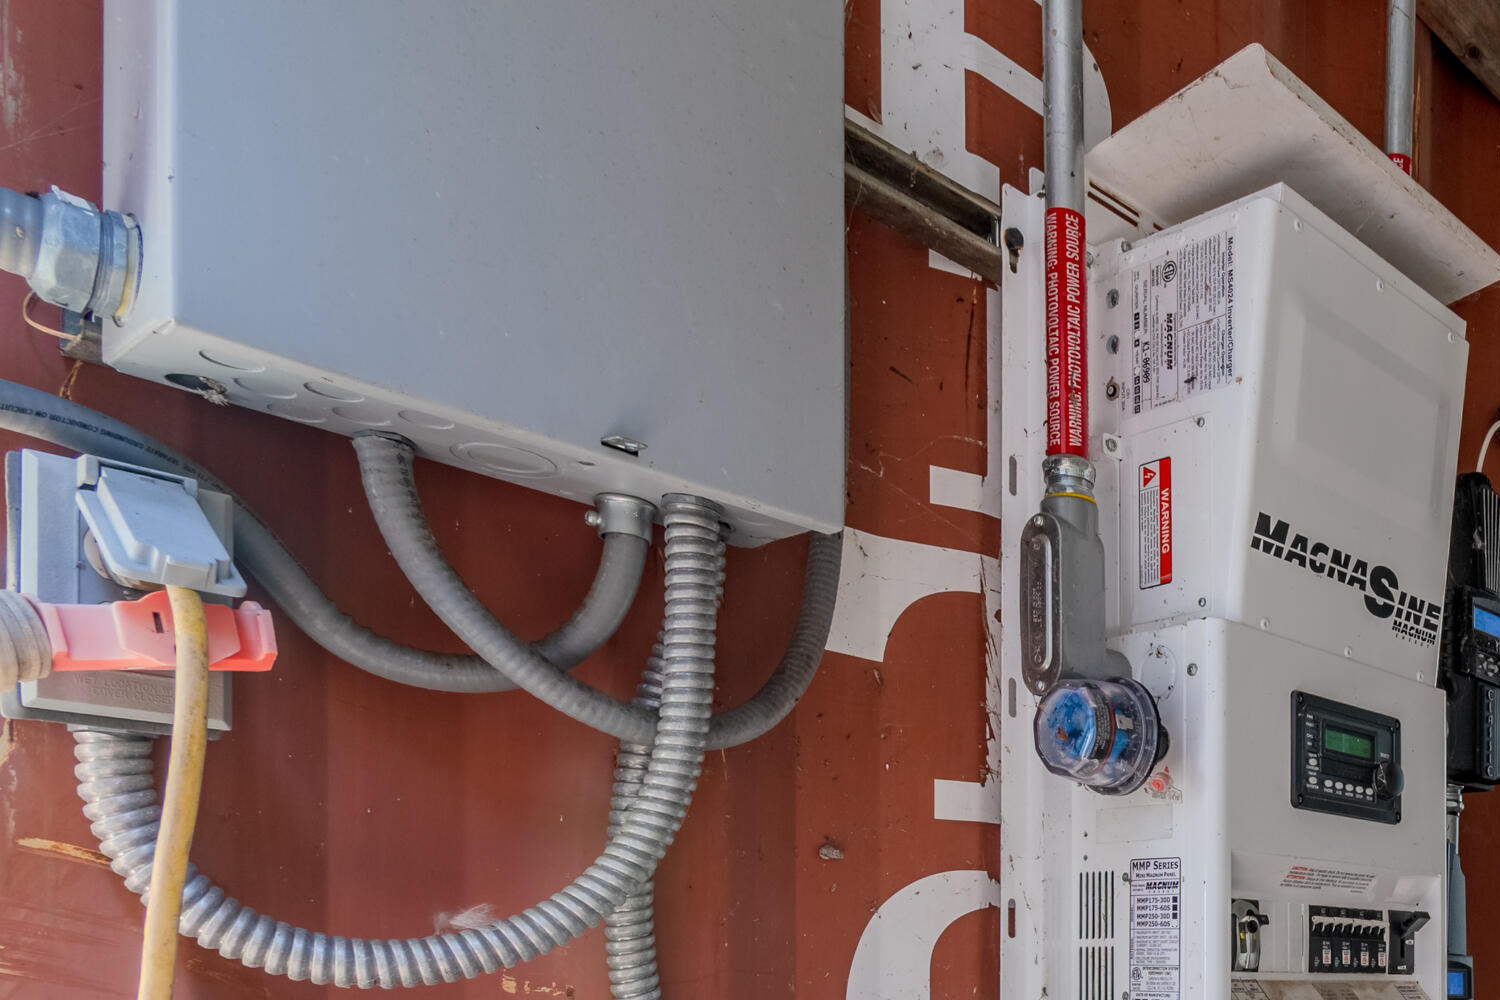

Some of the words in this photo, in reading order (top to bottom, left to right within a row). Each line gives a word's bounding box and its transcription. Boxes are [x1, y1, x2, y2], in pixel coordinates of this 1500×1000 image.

[1046, 212, 1059, 272] WARNING:
[1065, 214, 1080, 262] SOURCE
[1066, 262, 1080, 304] POWER
[1047, 272, 1059, 356] PHOTOVOLTAIC
[1067, 304, 1082, 388] PHOTOVOLTAIC
[1048, 358, 1060, 400] POWER
[35, 410, 47, 418] ON
[48, 414, 98, 433] CONDUCTOR
[1050, 400, 1061, 446] SOURCE
[1069, 388, 1082, 447] WARNING:
[1161, 488, 1170, 554] WARNING
[1392, 620, 1436, 645] MAGNUM
[1132, 861, 1151, 870] MMP
[1146, 881, 1179, 890] MAGNUM
